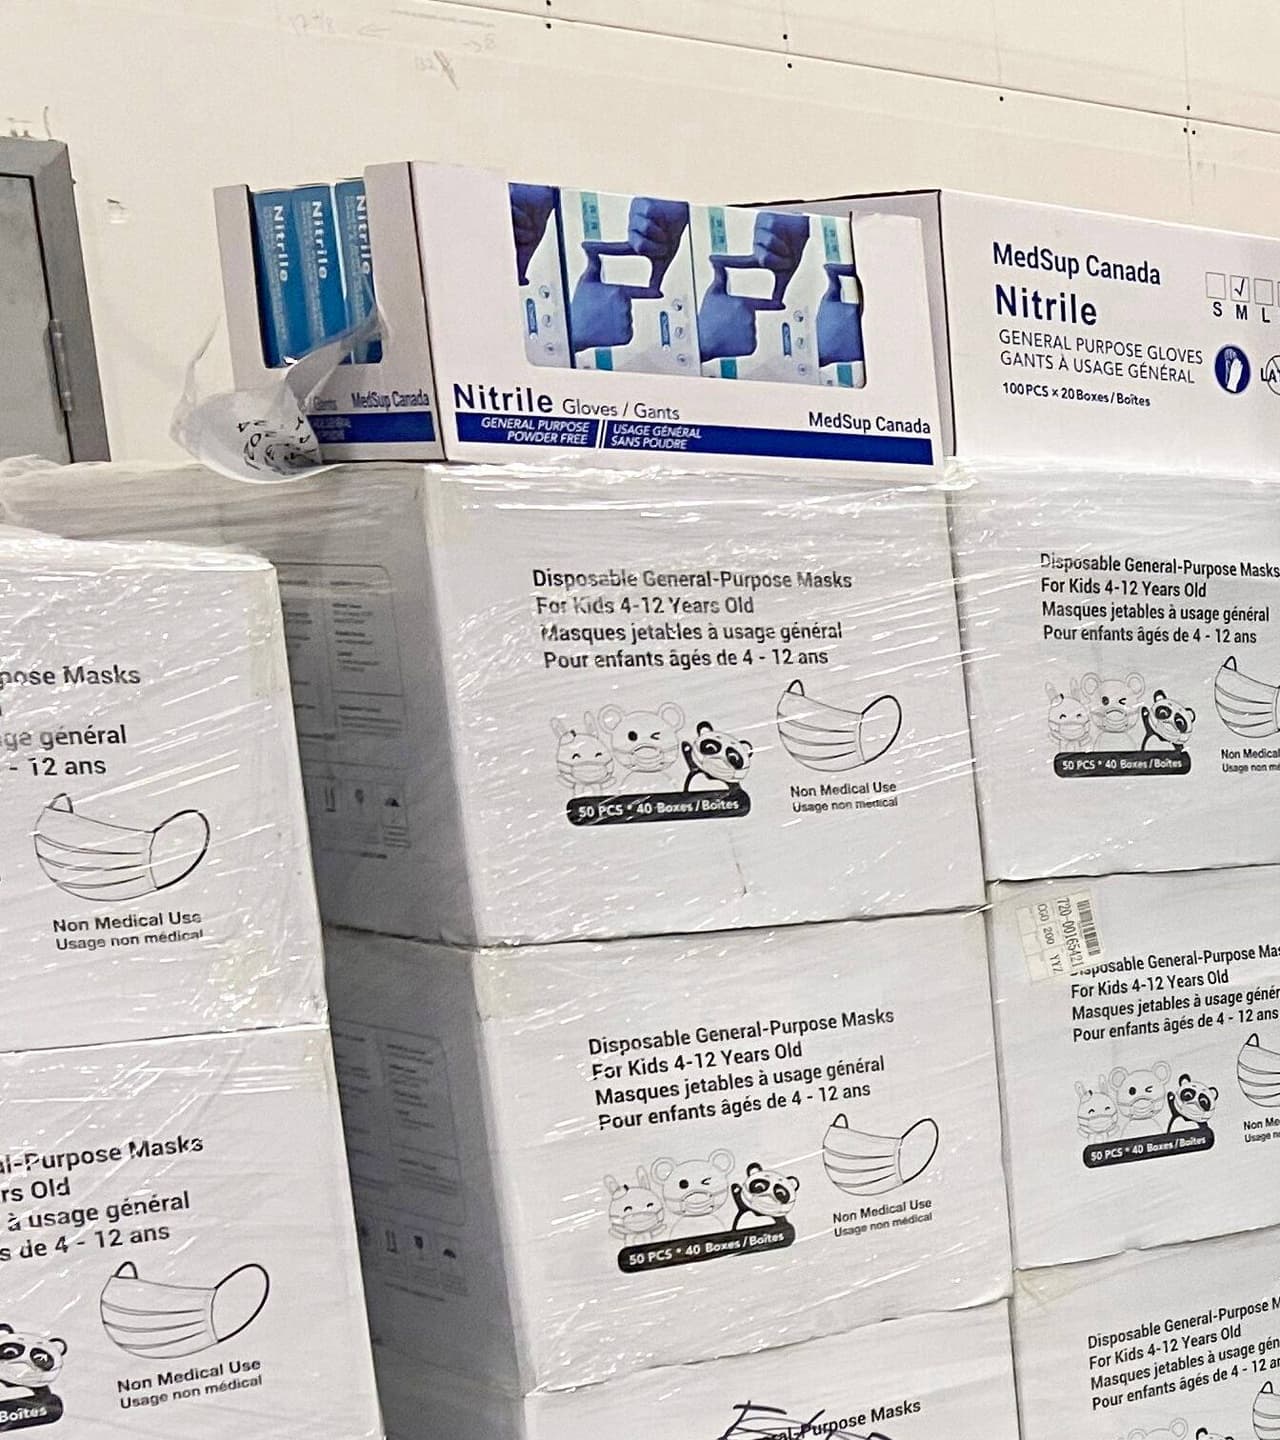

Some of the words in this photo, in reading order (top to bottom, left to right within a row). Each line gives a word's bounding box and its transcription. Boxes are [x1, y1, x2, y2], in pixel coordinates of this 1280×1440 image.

[273, 206, 288, 282] Nitrile
[312, 201, 328, 279] Nitrile
[993, 242, 1080, 279] MedSup
[1086, 255, 1161, 286] Canada
[995, 285, 1097, 326] Nitrile
[1212, 302, 1223, 318] S
[1235, 304, 1248, 321] M
[1261, 308, 1270, 324] L
[1000, 329, 1072, 351] GENERAL
[1076, 337, 1143, 358] PURPOSE
[1147, 345, 1203, 365] GLOVES
[1000, 351, 1054, 372] GANTS
[1058, 354, 1069, 375] À
[1073, 359, 1124, 378] USAGE
[1128, 361, 1195, 384] GÉNÉRAL
[454, 384, 553, 413] Nitrile
[563, 399, 617, 417] Gloves
[634, 403, 680, 420] Gants
[1117, 391, 1150, 408] Boîtes
[481, 417, 535, 431] GENERAL
[538, 420, 590, 433] PURPOSE
[507, 431, 557, 443] POWDER
[560, 433, 587, 444] FREE
[613, 424, 650, 436] USAGE
[652, 425, 702, 438] GÉNÉRAL
[809, 412, 871, 434] MedSup
[876, 416, 930, 434] Canada
[611, 436, 638, 447] SANS
[640, 437, 687, 449] POUDRE
[589, 1031, 691, 1056] Disposable
[695, 1016, 838, 1044] General-Purpose
[841, 1008, 894, 1028] Masks
[592, 1063, 622, 1080] For
[628, 1052, 669, 1074] Kids
[674, 1052, 717, 1072] 4-12
[721, 1046, 770, 1066] Years
[775, 1042, 802, 1059] Old
[595, 1083, 679, 1107] Masques
[683, 1070, 754, 1099] jetables
[759, 1067, 769, 1086] à
[773, 1067, 822, 1088] usage
[826, 1055, 885, 1082] général
[599, 1111, 643, 1130] Pour
[648, 1102, 716, 1124] enfants
[721, 1095, 762, 1119] âgés
[767, 1092, 787, 1109] de
[791, 1091, 802, 1106] 4
[819, 1086, 838, 1103] 12
[843, 1082, 870, 1099] ans
